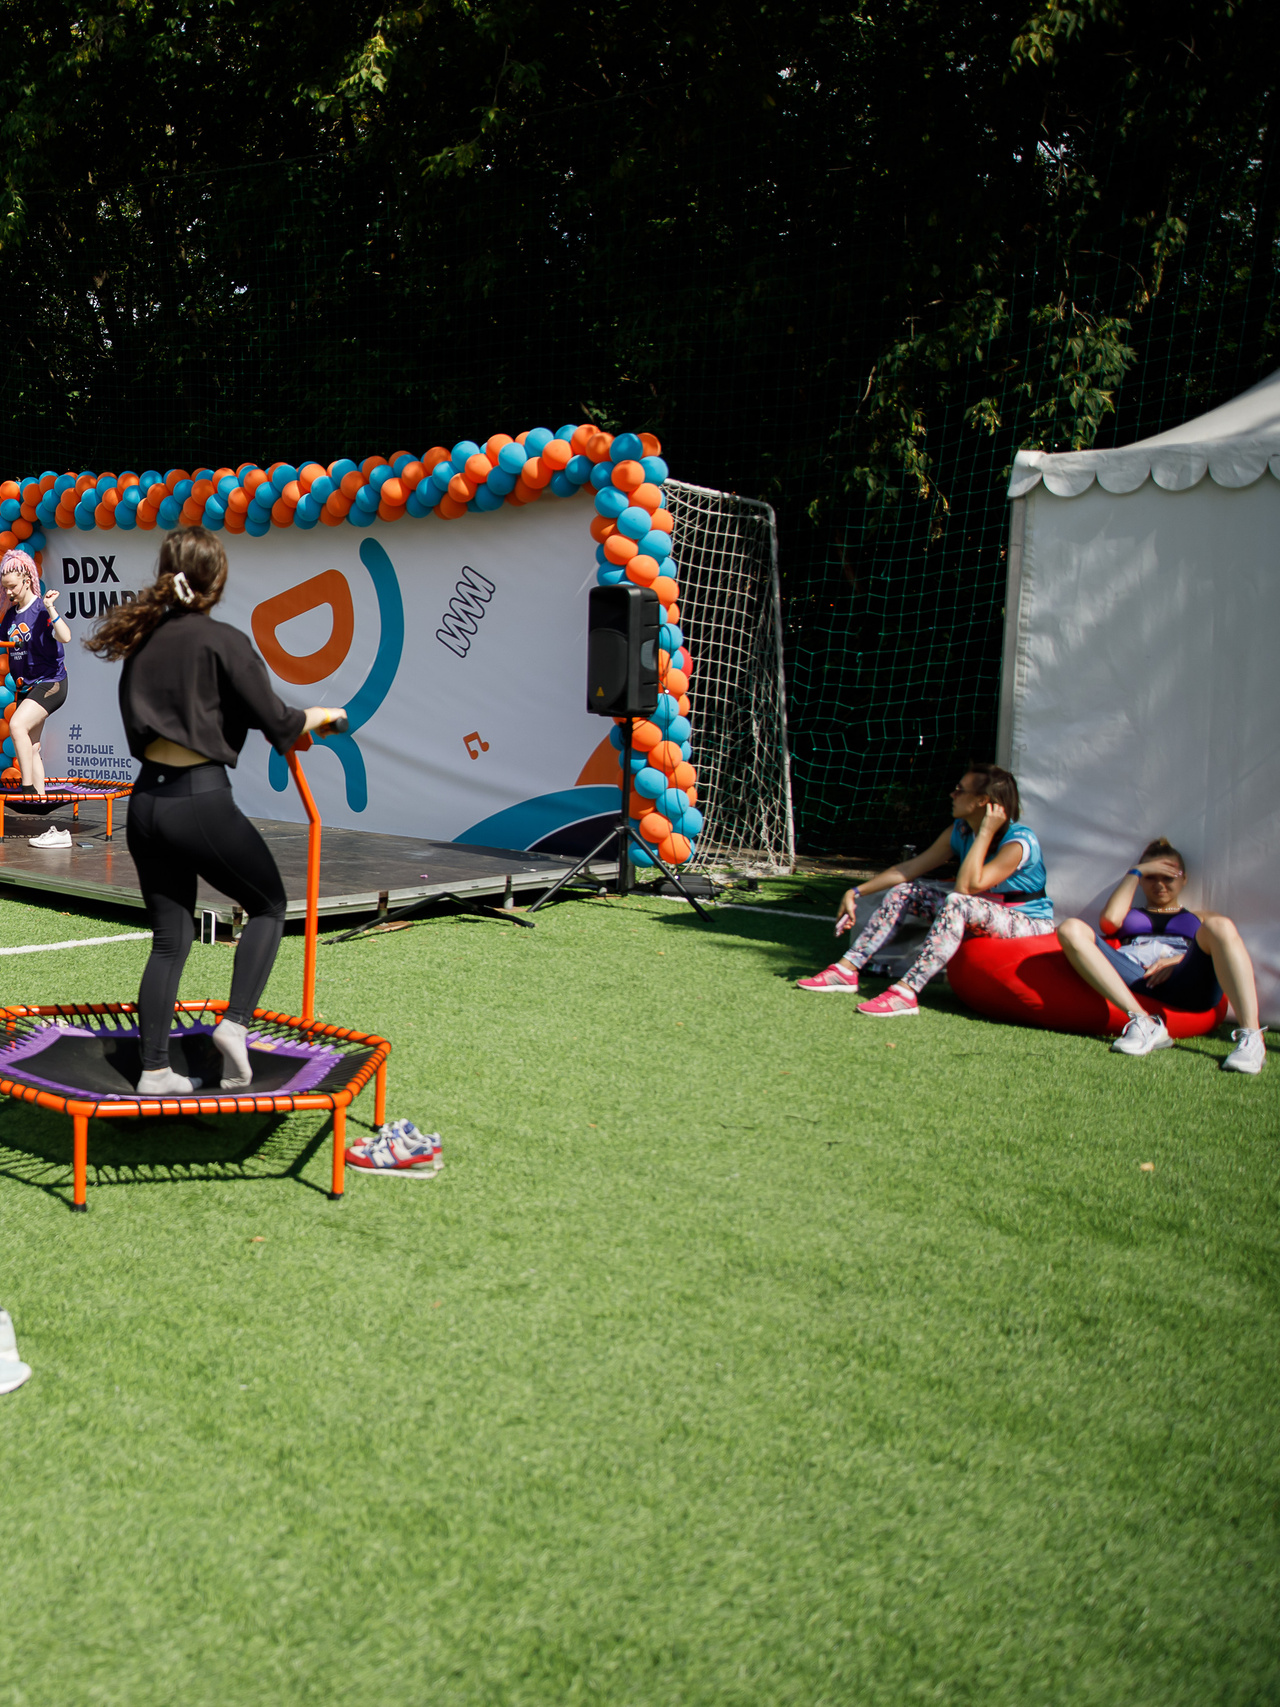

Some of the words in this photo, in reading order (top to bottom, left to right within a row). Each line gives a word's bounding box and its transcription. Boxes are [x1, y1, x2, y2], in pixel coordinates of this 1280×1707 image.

[62, 555, 120, 584] DDX
[64, 590, 144, 619] JUMP
[67, 744, 114, 755] БОЛЬШЕ
[67, 756, 132, 769] ЧЕМФИТНЕС
[67, 768, 132, 781] ФЕСТИВАЛЬ
